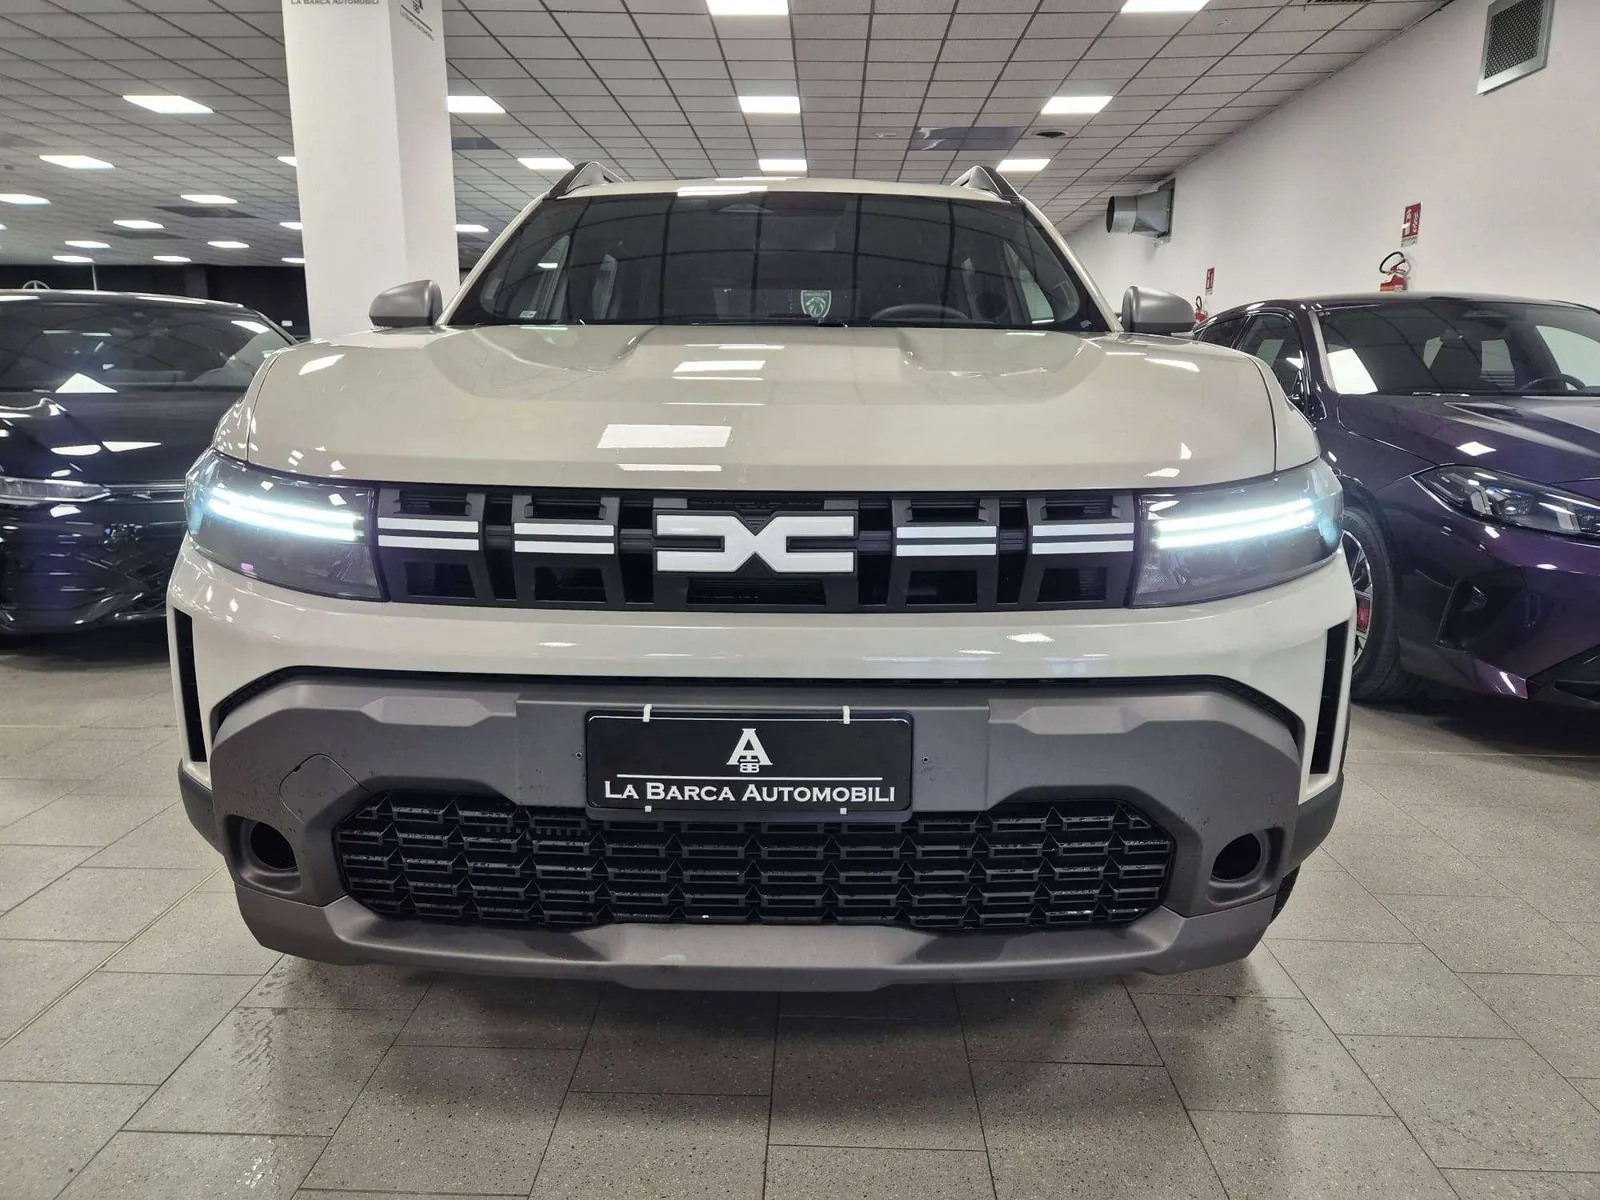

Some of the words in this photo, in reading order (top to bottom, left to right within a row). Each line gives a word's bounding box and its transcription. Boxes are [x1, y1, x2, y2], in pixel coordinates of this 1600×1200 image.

[604, 780, 640, 800] LA
[645, 781, 736, 802] BARCA
[741, 783, 896, 803] AUTOMOBILI
